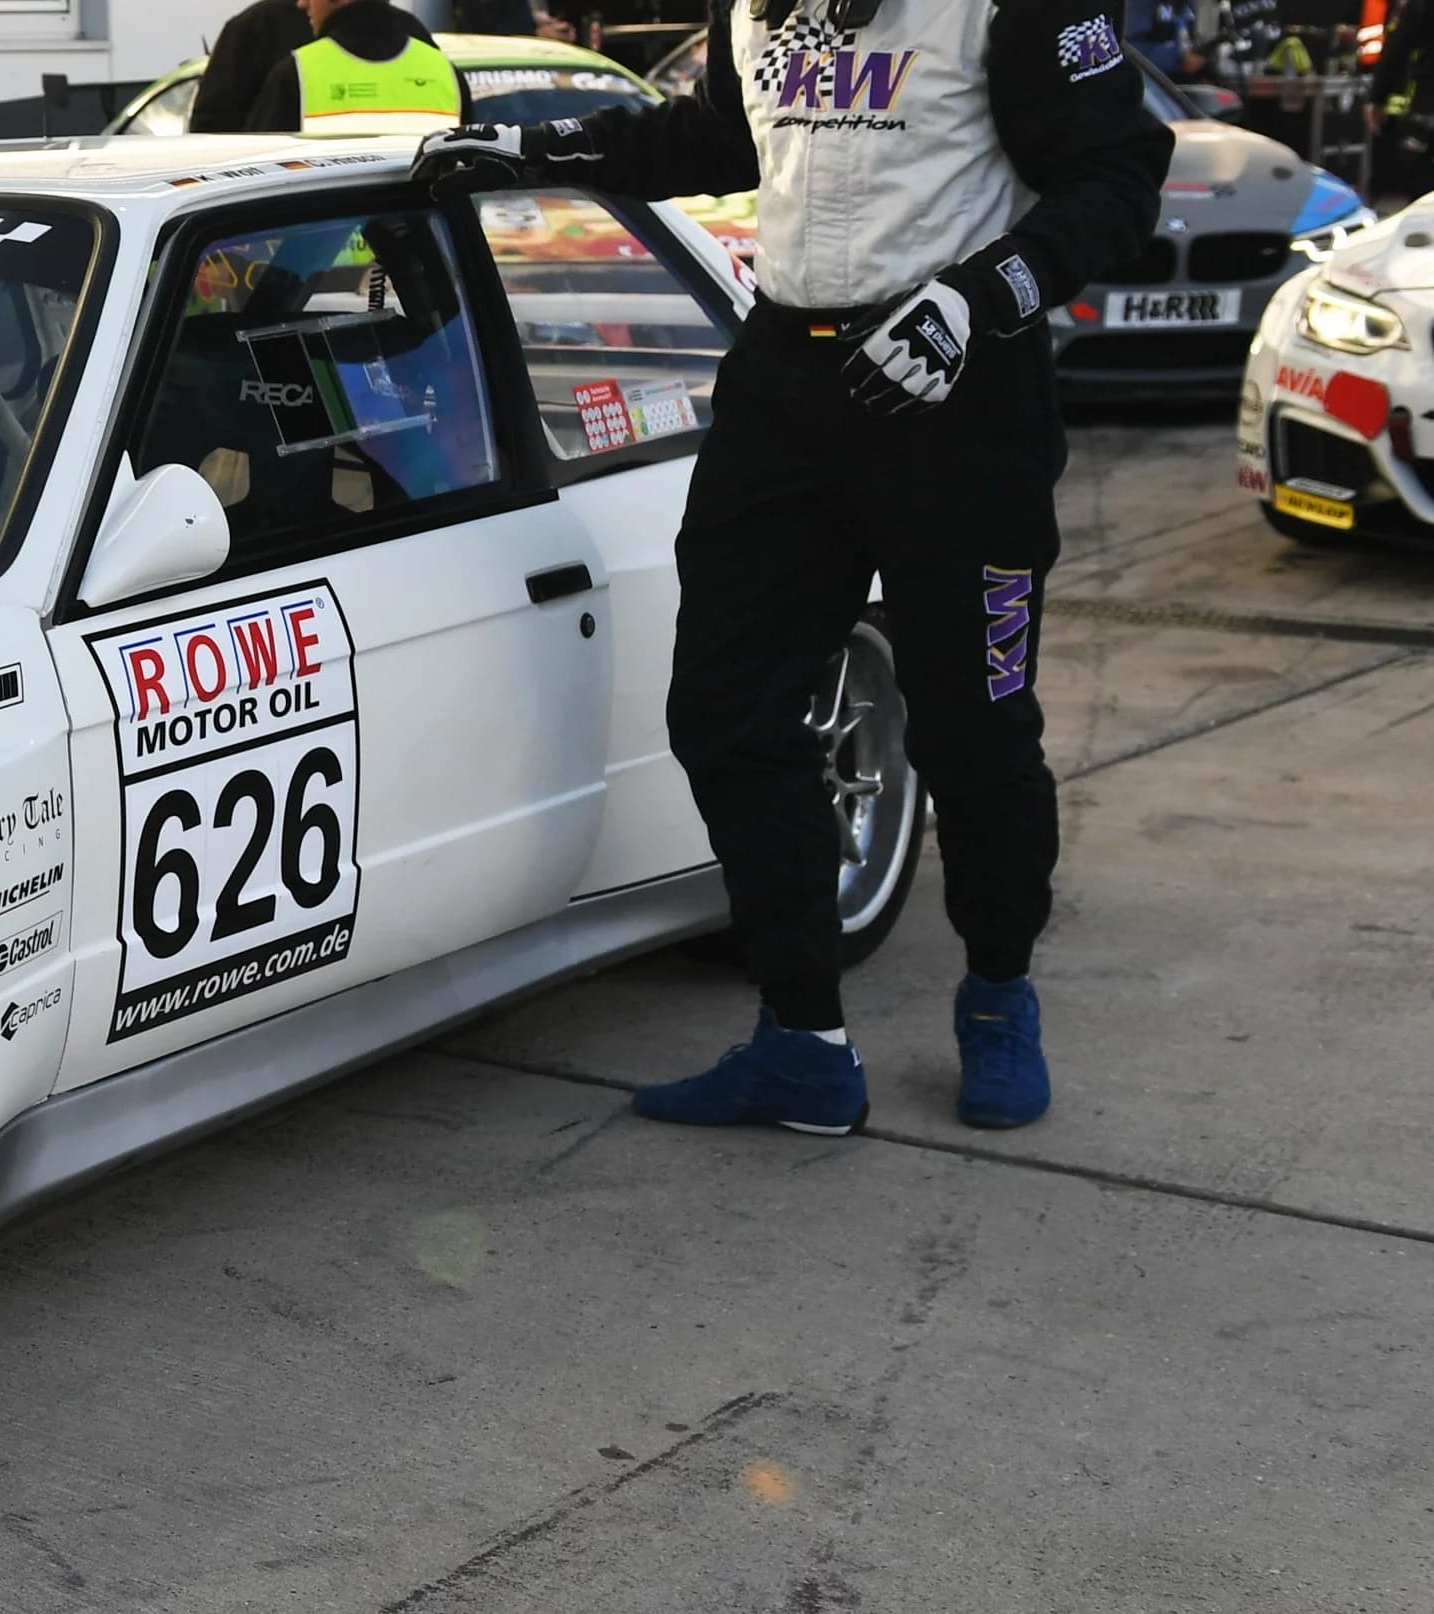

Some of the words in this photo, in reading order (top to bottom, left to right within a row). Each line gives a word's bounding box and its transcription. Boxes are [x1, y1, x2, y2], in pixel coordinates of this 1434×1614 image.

[465, 70, 551, 87] URISMO
[776, 50, 917, 112] KW
[239, 380, 314, 407] RECA
[1275, 366, 1326, 400] AVIA
[983, 564, 1033, 701] KW
[129, 607, 322, 722] ROWE
[137, 696, 258, 757] MOTOR
[269, 681, 320, 718] OIL
[22, 787, 63, 830] Tale
[132, 746, 343, 960] 626
[8, 920, 54, 967] Castrol
[114, 923, 350, 1032] www.rowe.com.de
